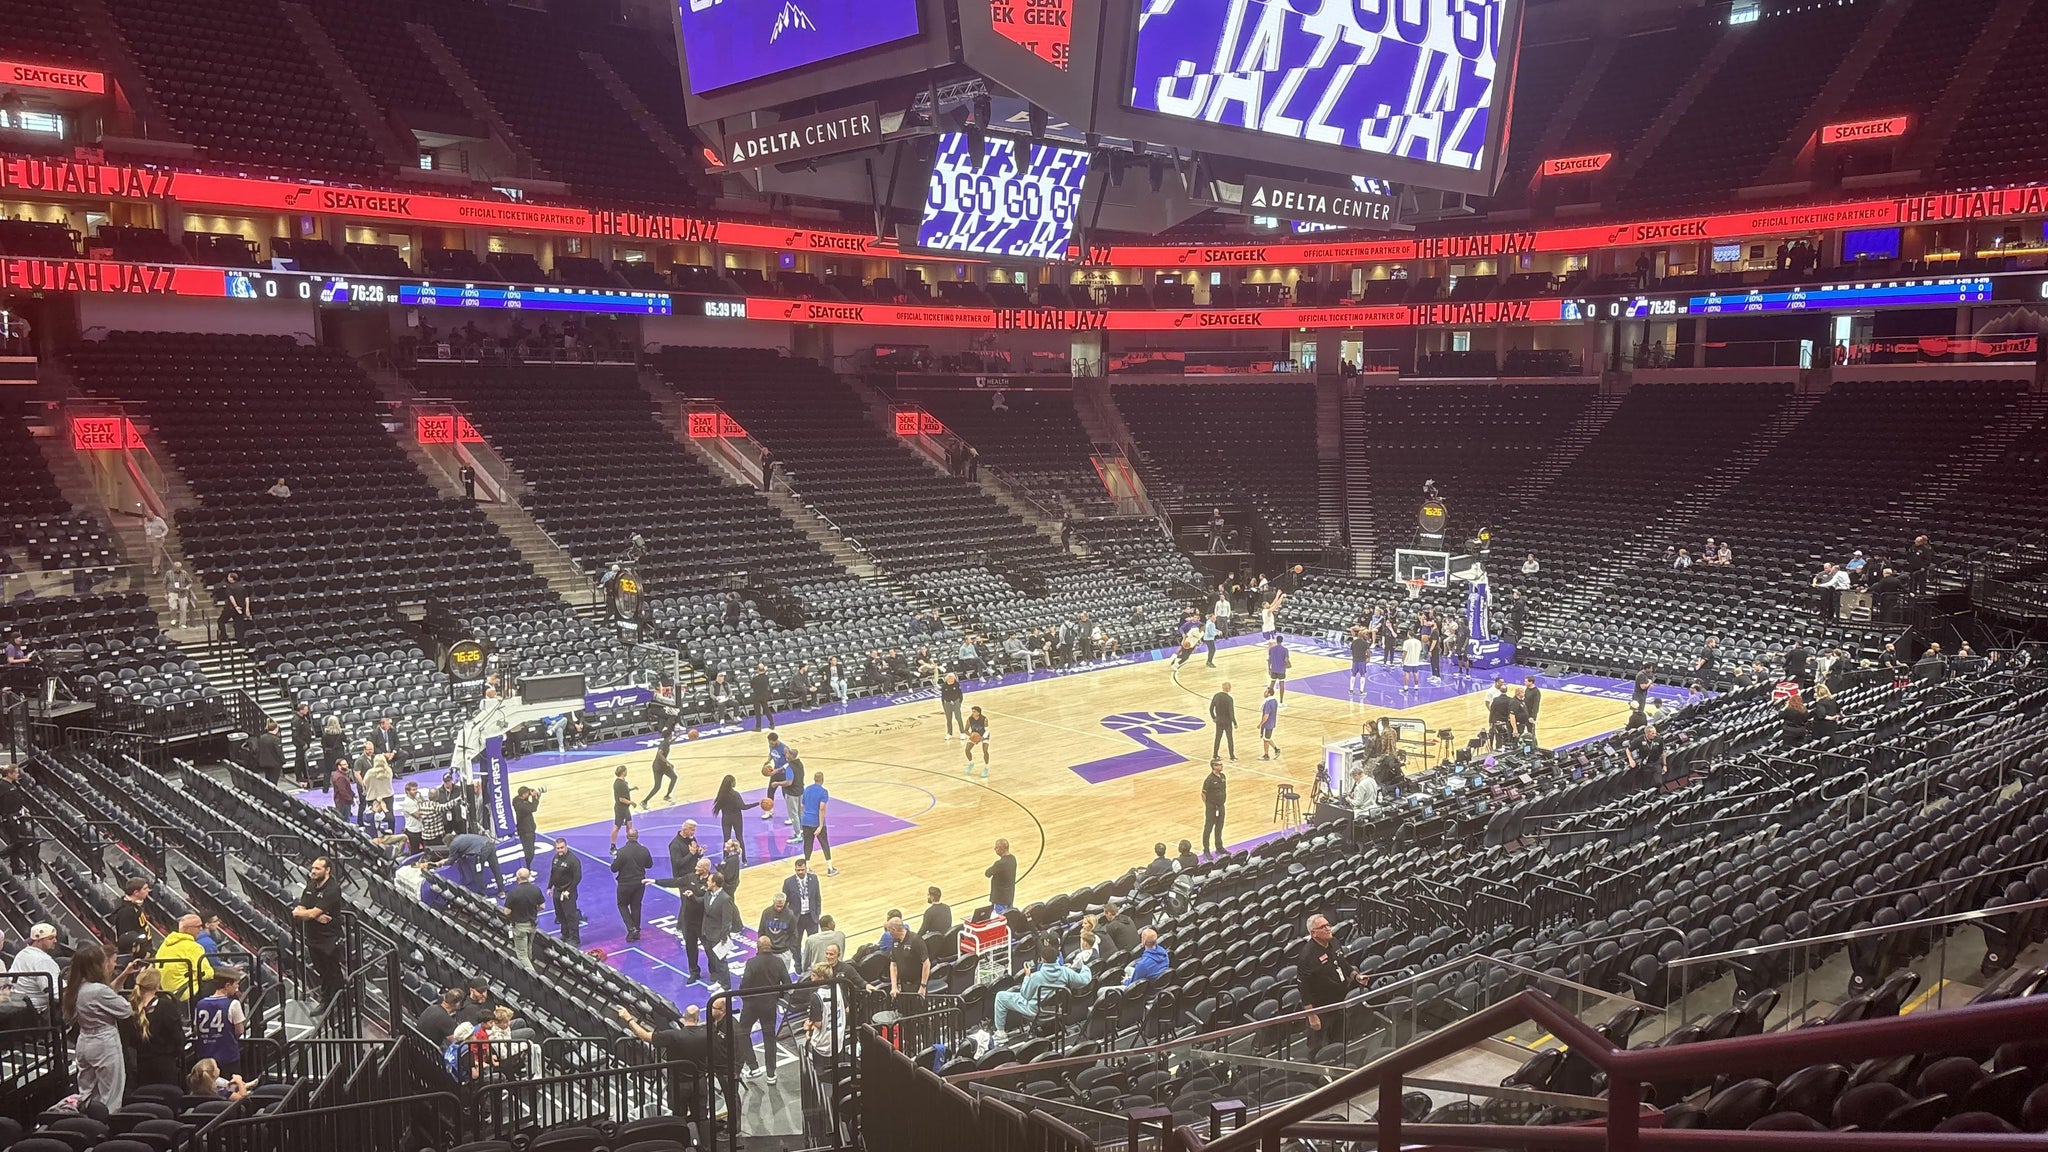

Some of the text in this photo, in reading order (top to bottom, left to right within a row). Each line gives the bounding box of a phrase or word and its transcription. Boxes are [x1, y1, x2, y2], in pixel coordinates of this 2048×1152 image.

[1024, 8, 1067, 27] GEEK
[14, 67, 88, 88] SEATGEEK
[1155, 0, 1381, 146] JAZZ
[1359, 46, 1493, 171] JAZ
[748, 114, 872, 158] DELTA CENTER
[1835, 121, 1893, 139] SEATGEEK
[1554, 157, 1601, 172] SEATGEEK
[26, 160, 100, 194] UTAH
[108, 167, 177, 199] JAZZ
[324, 190, 412, 215] SEATGEEK
[955, 172, 996, 215] GO
[1004, 179, 1042, 220] GO
[1272, 190, 1390, 220] DELTA CENTER
[1893, 187, 2048, 223] THE UTAH JA
[459, 207, 586, 226] OFFICIAL TICKETING PARTNER OF
[1752, 208, 1890, 228] OFFICIAL TICKETING PARTNER OF
[589, 211, 720, 242] THE UTAH JAZZ
[927, 211, 1020, 254] JAZZ
[1636, 220, 1708, 240] SEATGEEK
[810, 234, 866, 252] SEATGEEK
[1304, 246, 1410, 258] OFFICIAL TICKETING PARTNER OF
[1413, 232, 1538, 258] THE UTAH JAZZ
[1204, 248, 1267, 262] SEATGEEK
[27, 260, 101, 291] UTAH
[109, 264, 177, 295] JAZZ
[266, 281, 277, 296] 0
[300, 282, 310, 298] 0
[351, 285, 384, 302] 76:26
[705, 302, 745, 318] 05:39 PM
[809, 304, 864, 321] SEATGEEK
[1408, 301, 1531, 325] THE UTAH JAZZ
[1588, 304, 1596, 317] 0
[1610, 303, 1619, 316] 0
[1650, 300, 1676, 314] 76:26
[897, 312, 991, 322] OFFICIAL TICKETING PARTNER OF
[993, 309, 1108, 330] THE UTAH JAZZ
[1200, 312, 1262, 326] SEATGEEK
[1298, 311, 1404, 322] OFFICIAL TICKETING PARTNER OF
[83, 422, 113, 433] SEAT
[424, 420, 448, 430] SEAT
[694, 418, 712, 426] SEAT
[82, 434, 116, 444] GEEK
[424, 430, 448, 438] GEEK
[454, 651, 480, 663] 76:26
[492, 757, 508, 830] AMERICA FIRST
[198, 1010, 224, 1033] 24
